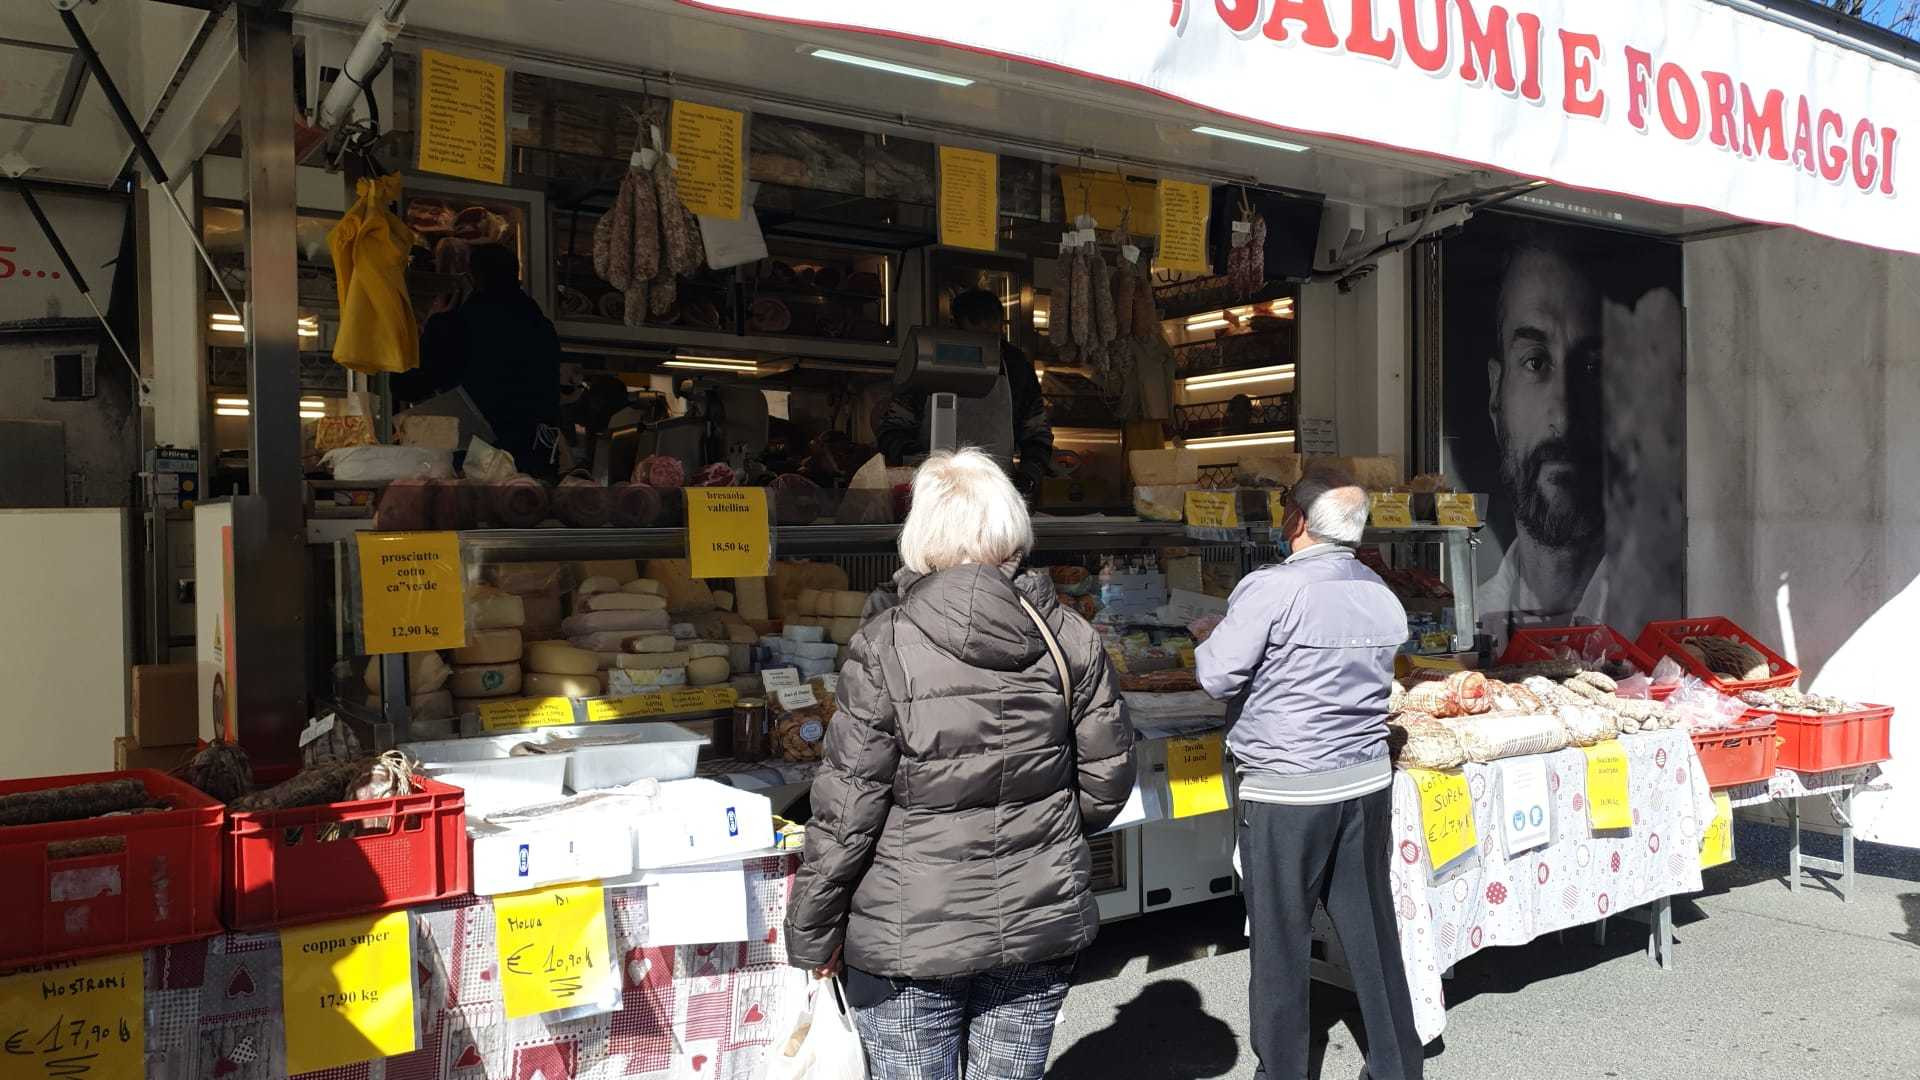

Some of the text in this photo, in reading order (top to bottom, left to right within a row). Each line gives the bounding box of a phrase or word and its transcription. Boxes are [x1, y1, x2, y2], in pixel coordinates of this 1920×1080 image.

[1559, 27, 1605, 119] E
[1625, 44, 1899, 195] FORMAGGI
[707, 503, 751, 513] valtellina
[712, 542, 750, 553] 18,50 kg
[382, 551, 440, 565] prosciutto
[397, 568, 425, 578] cotto
[392, 624, 440, 637] 12,90 kg
[303, 931, 389, 955] coppa super
[507, 943, 534, 975] €
[362, 988, 379, 1002] kg
[5, 1028, 35, 1055] €
[36, 1013, 110, 1053] 17,90
